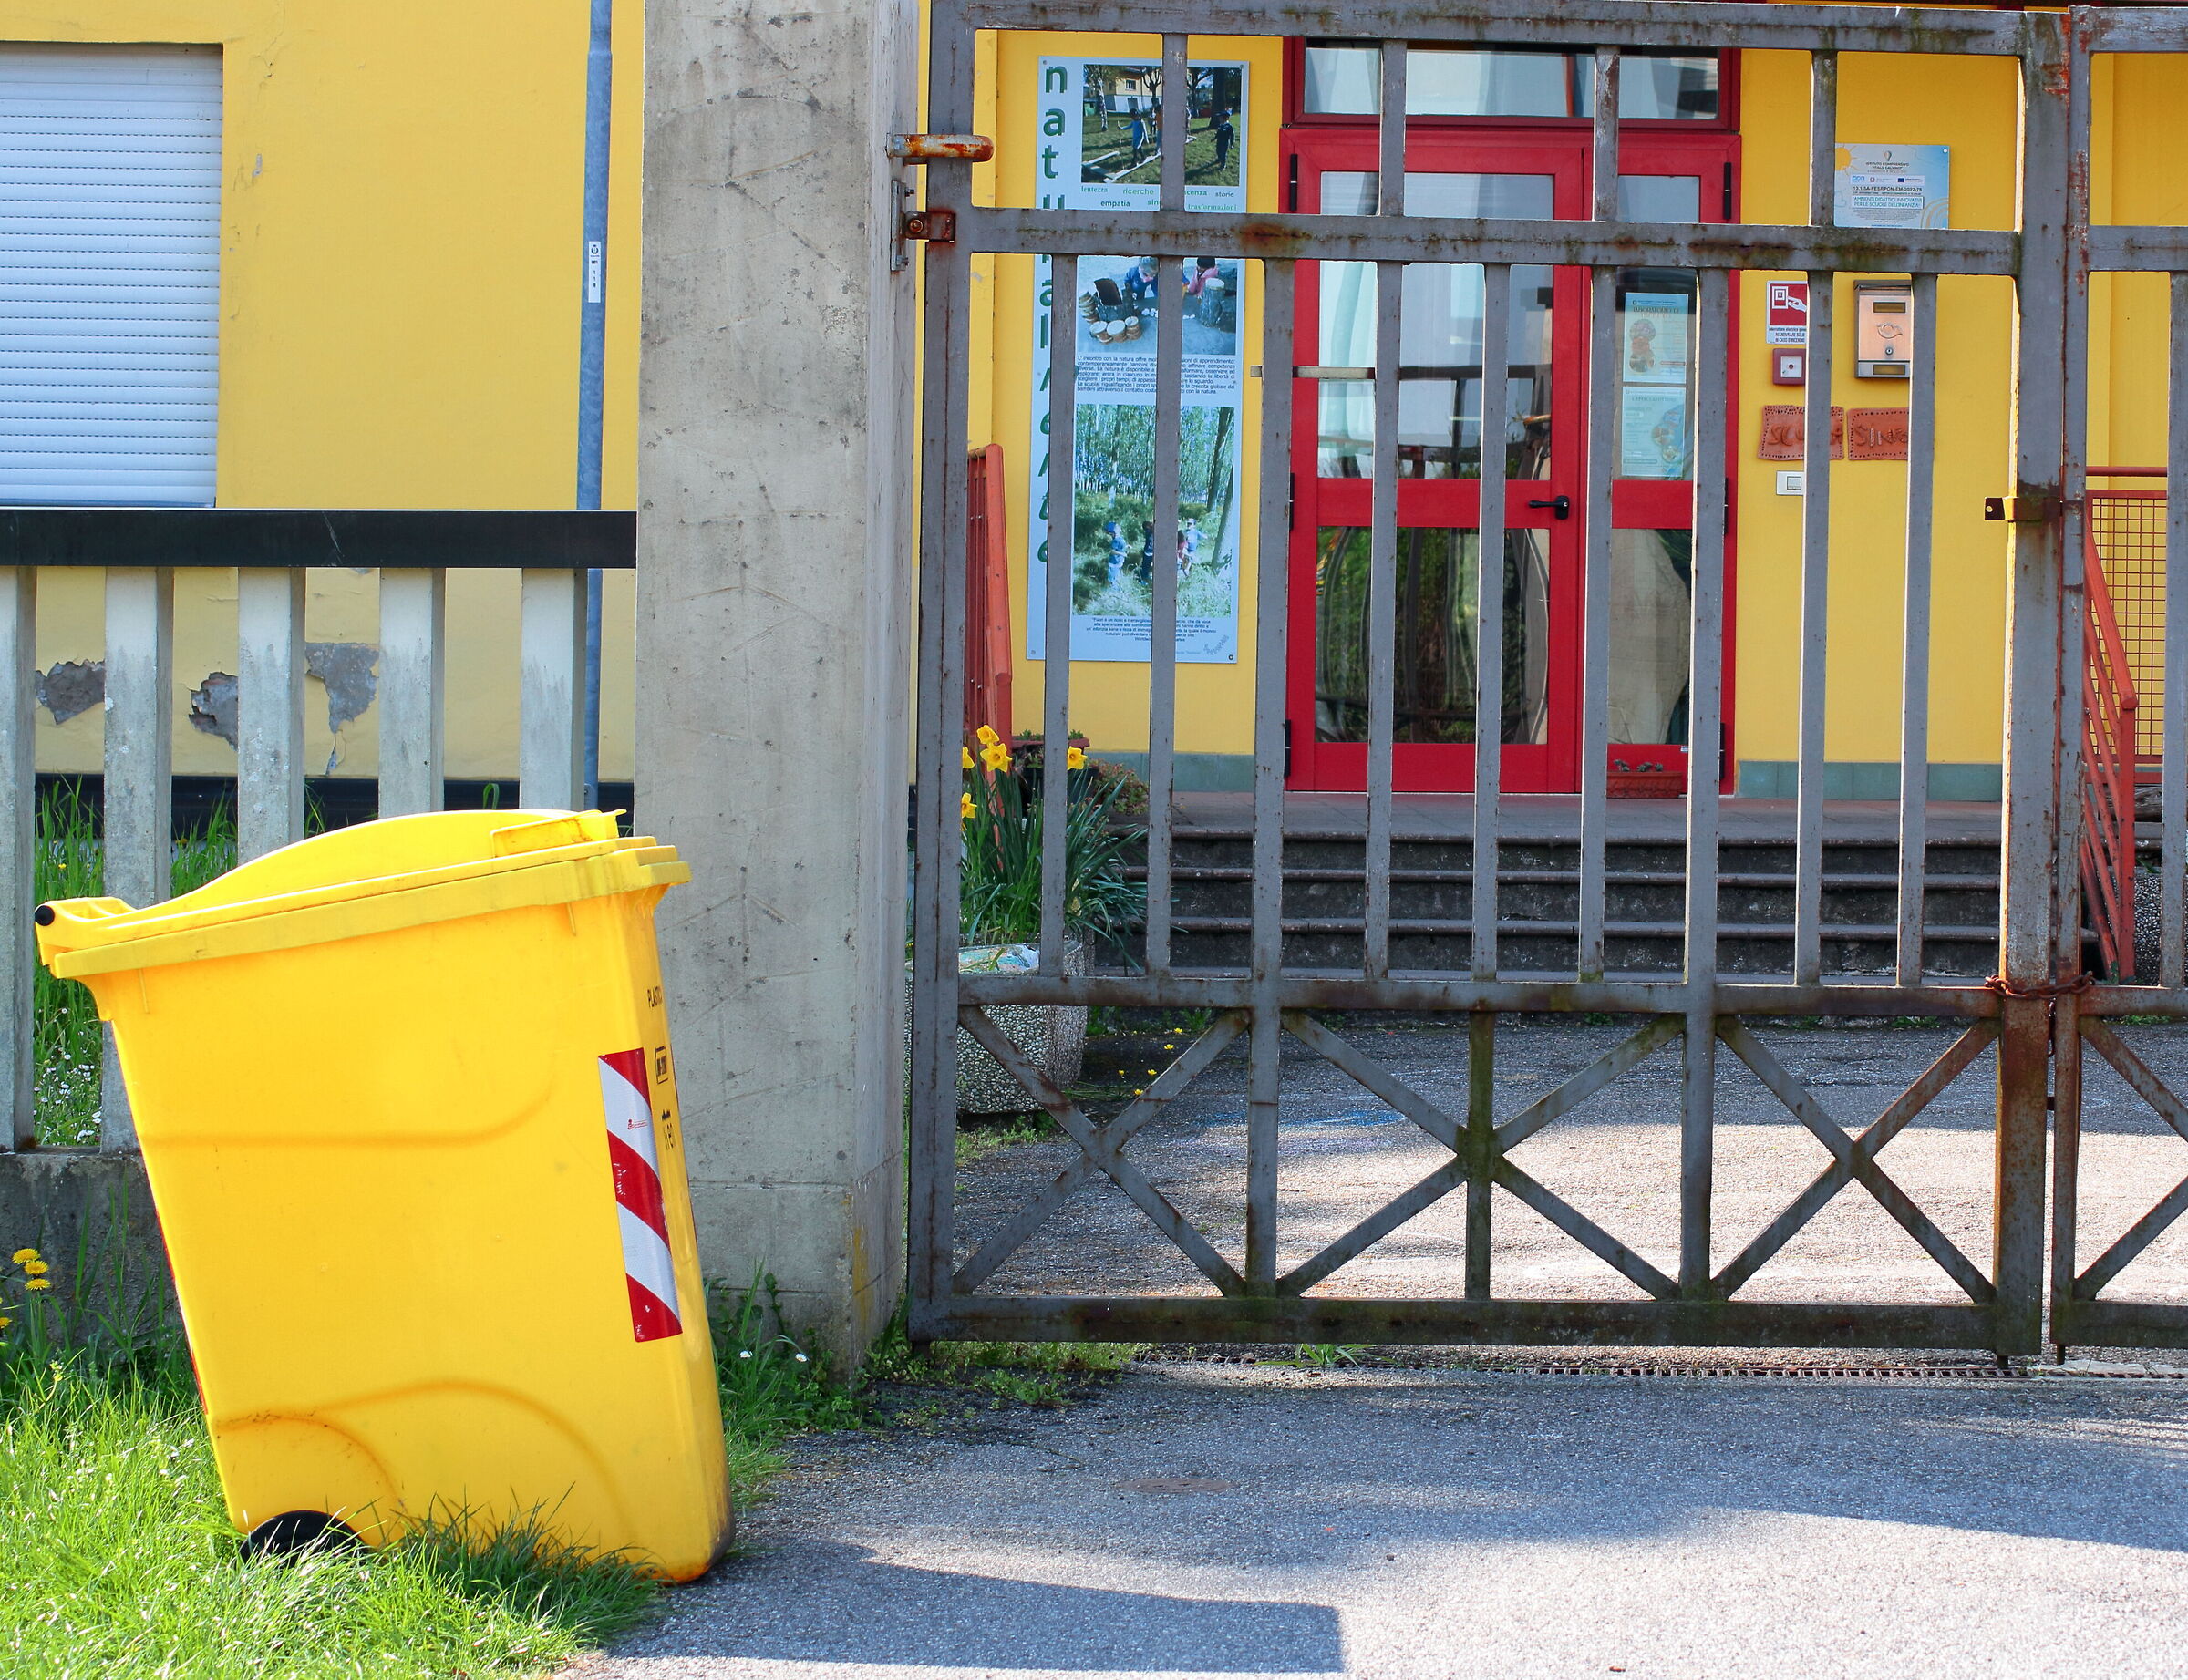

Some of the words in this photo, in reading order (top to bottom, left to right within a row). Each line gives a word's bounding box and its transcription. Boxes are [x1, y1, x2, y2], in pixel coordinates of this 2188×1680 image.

[1081, 185, 1108, 193] lentezza
[1123, 187, 1154, 195] ricerche
[1100, 200, 1130, 208] empatia
